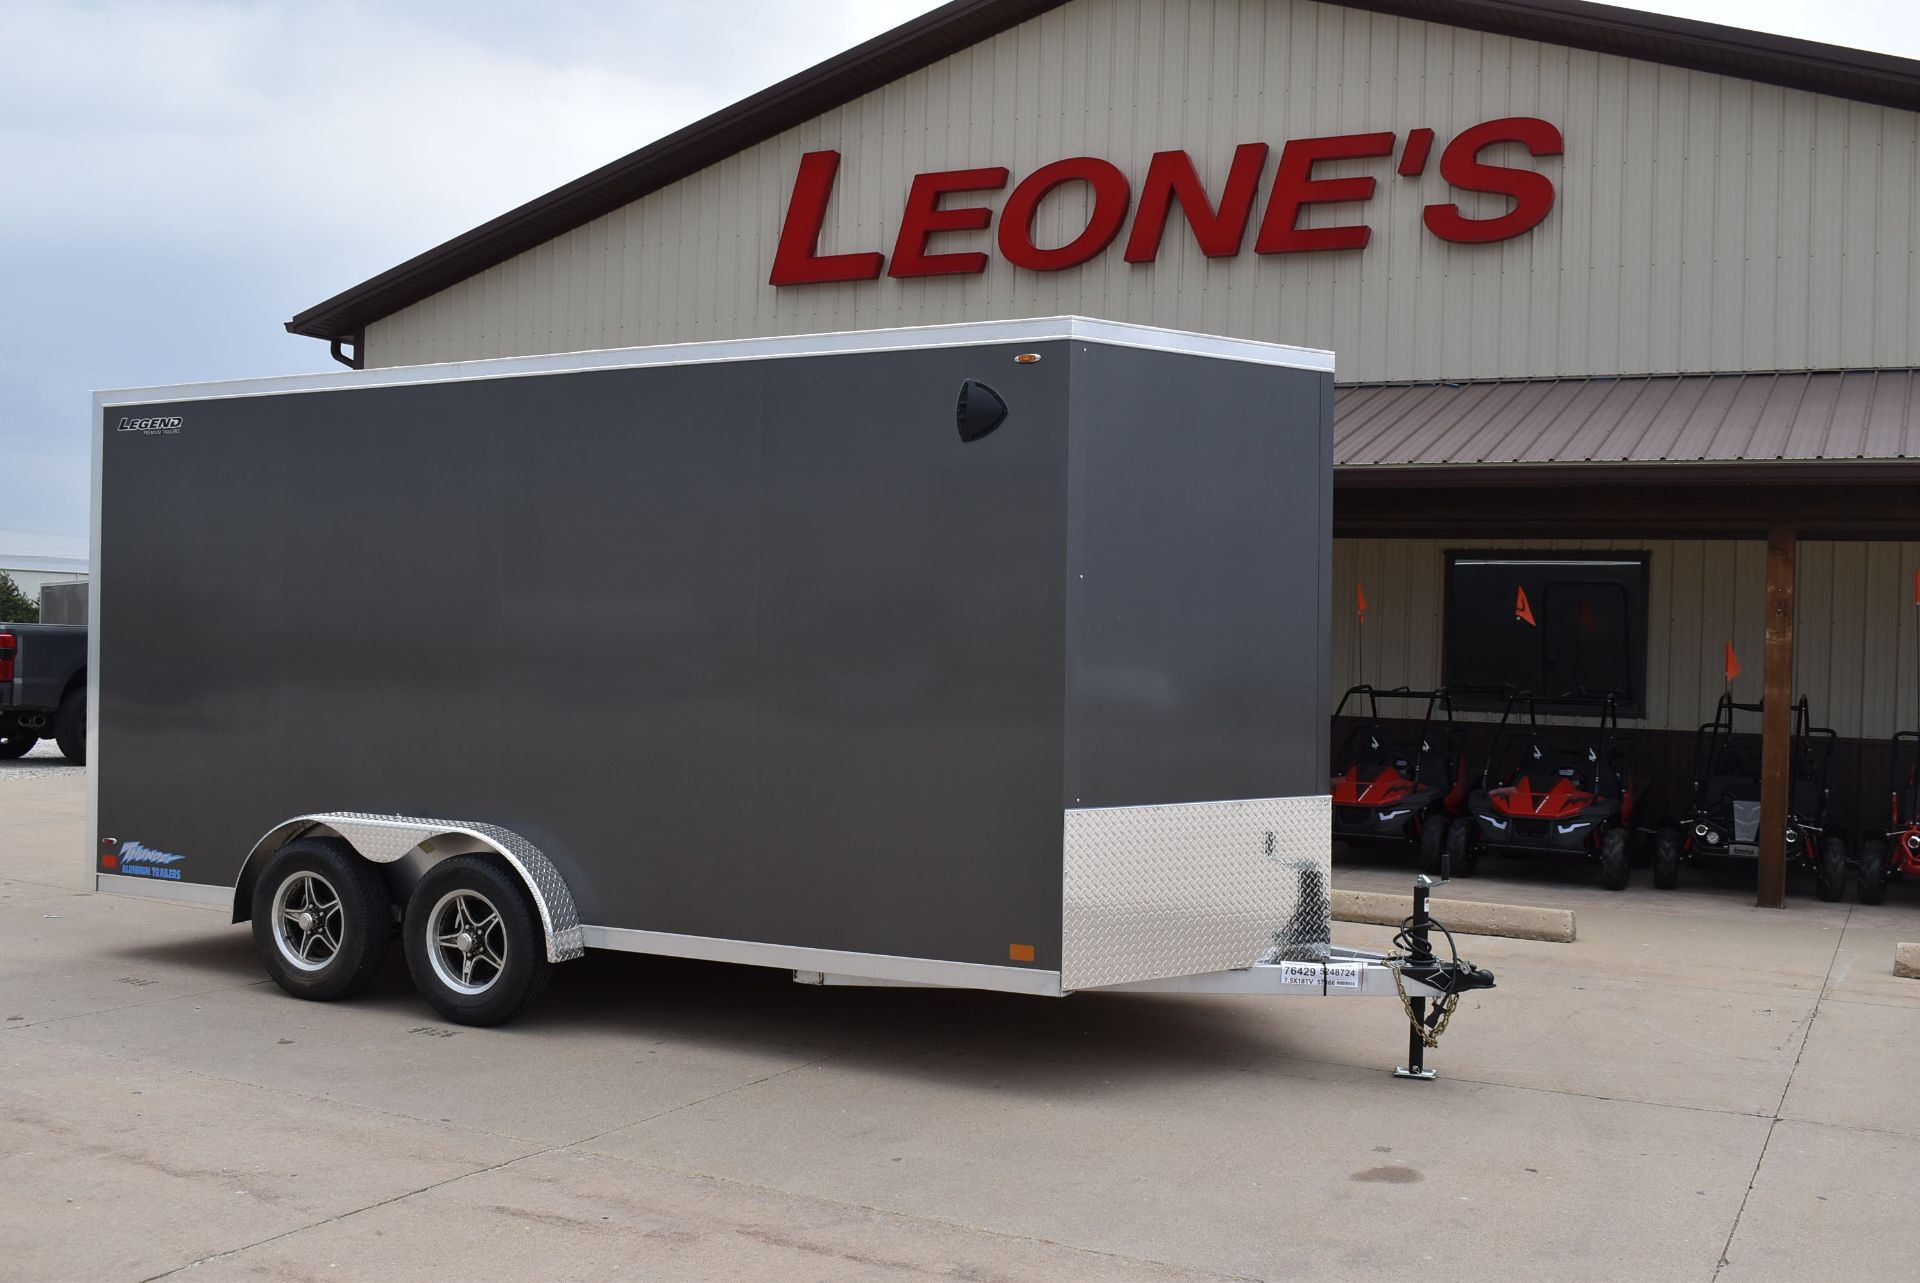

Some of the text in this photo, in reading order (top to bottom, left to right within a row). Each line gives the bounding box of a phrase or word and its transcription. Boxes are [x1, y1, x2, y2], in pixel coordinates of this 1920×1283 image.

[769, 117, 1564, 286] LEONE'S
[117, 416, 183, 432] LEGEND
[151, 866, 181, 880] TRAILERS
[1284, 966, 1316, 977] 76429
